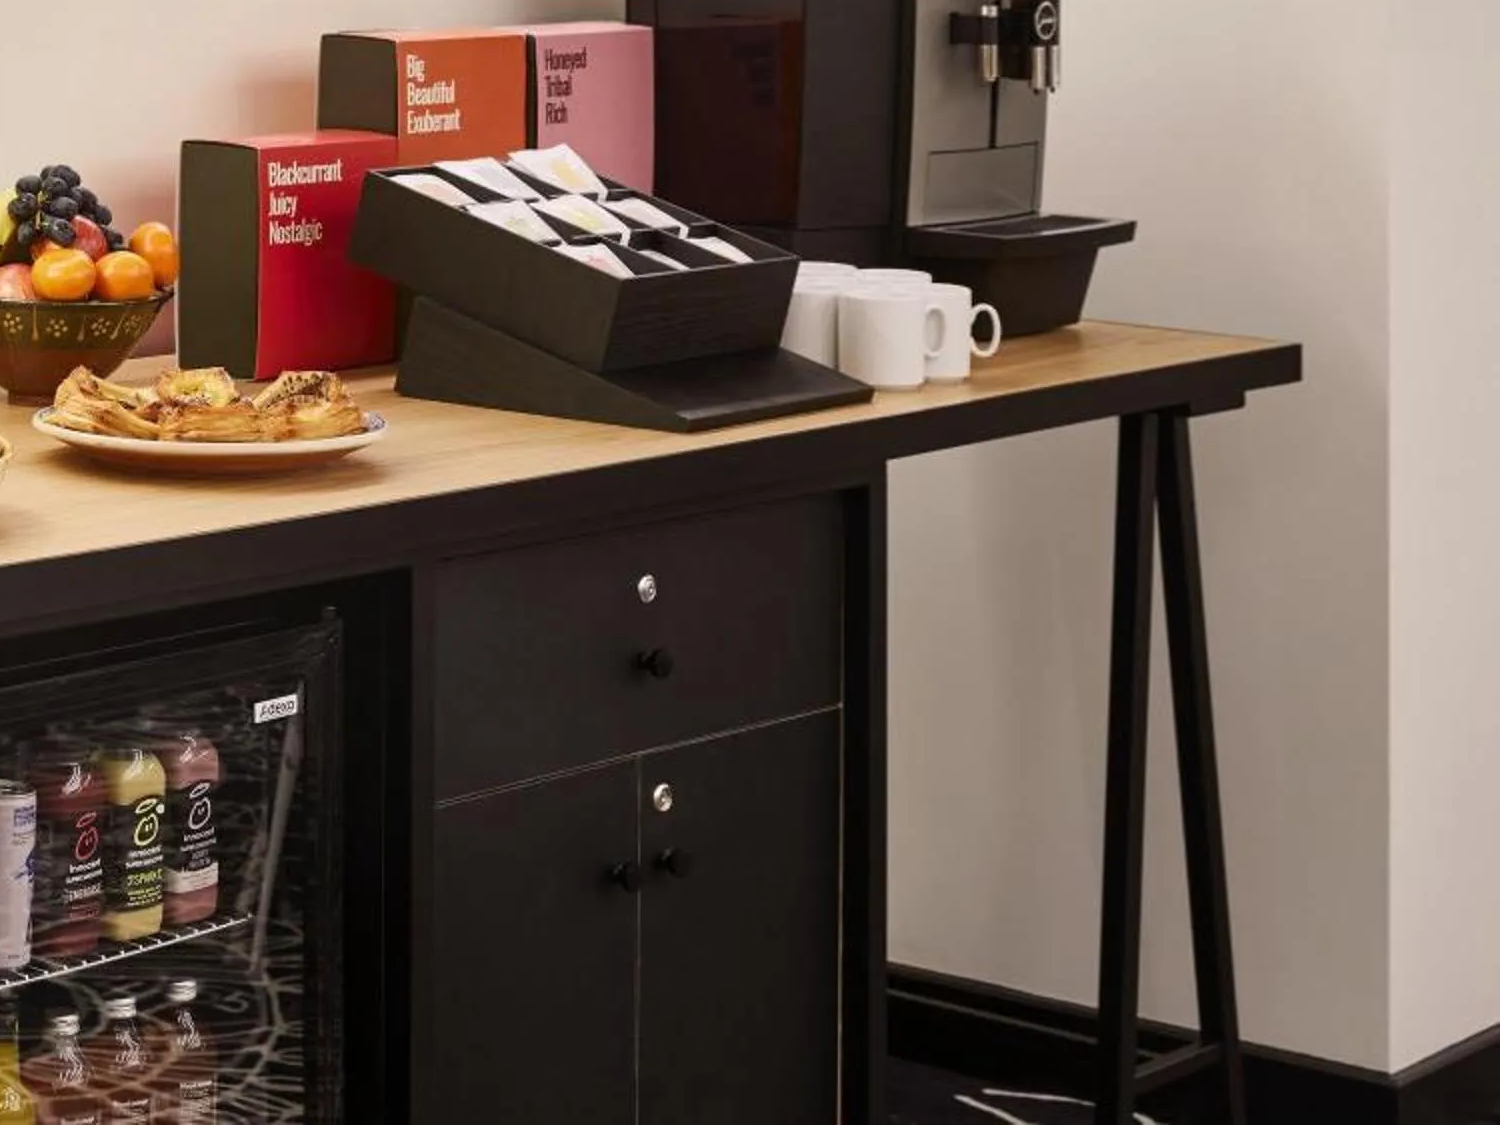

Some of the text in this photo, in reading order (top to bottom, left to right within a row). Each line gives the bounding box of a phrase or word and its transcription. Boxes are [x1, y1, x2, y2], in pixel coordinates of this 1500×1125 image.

[406, 54, 425, 82] Big
[544, 47, 587, 72] Honeyed
[407, 80, 455, 106] Beautiful
[545, 76, 572, 98] Tribal
[407, 108, 461, 135] Exuberant
[545, 102, 568, 125] Rich
[268, 158, 343, 187] Blackcurrant
[268, 191, 298, 218] Juicy
[269, 218, 323, 246] Nostalgic
